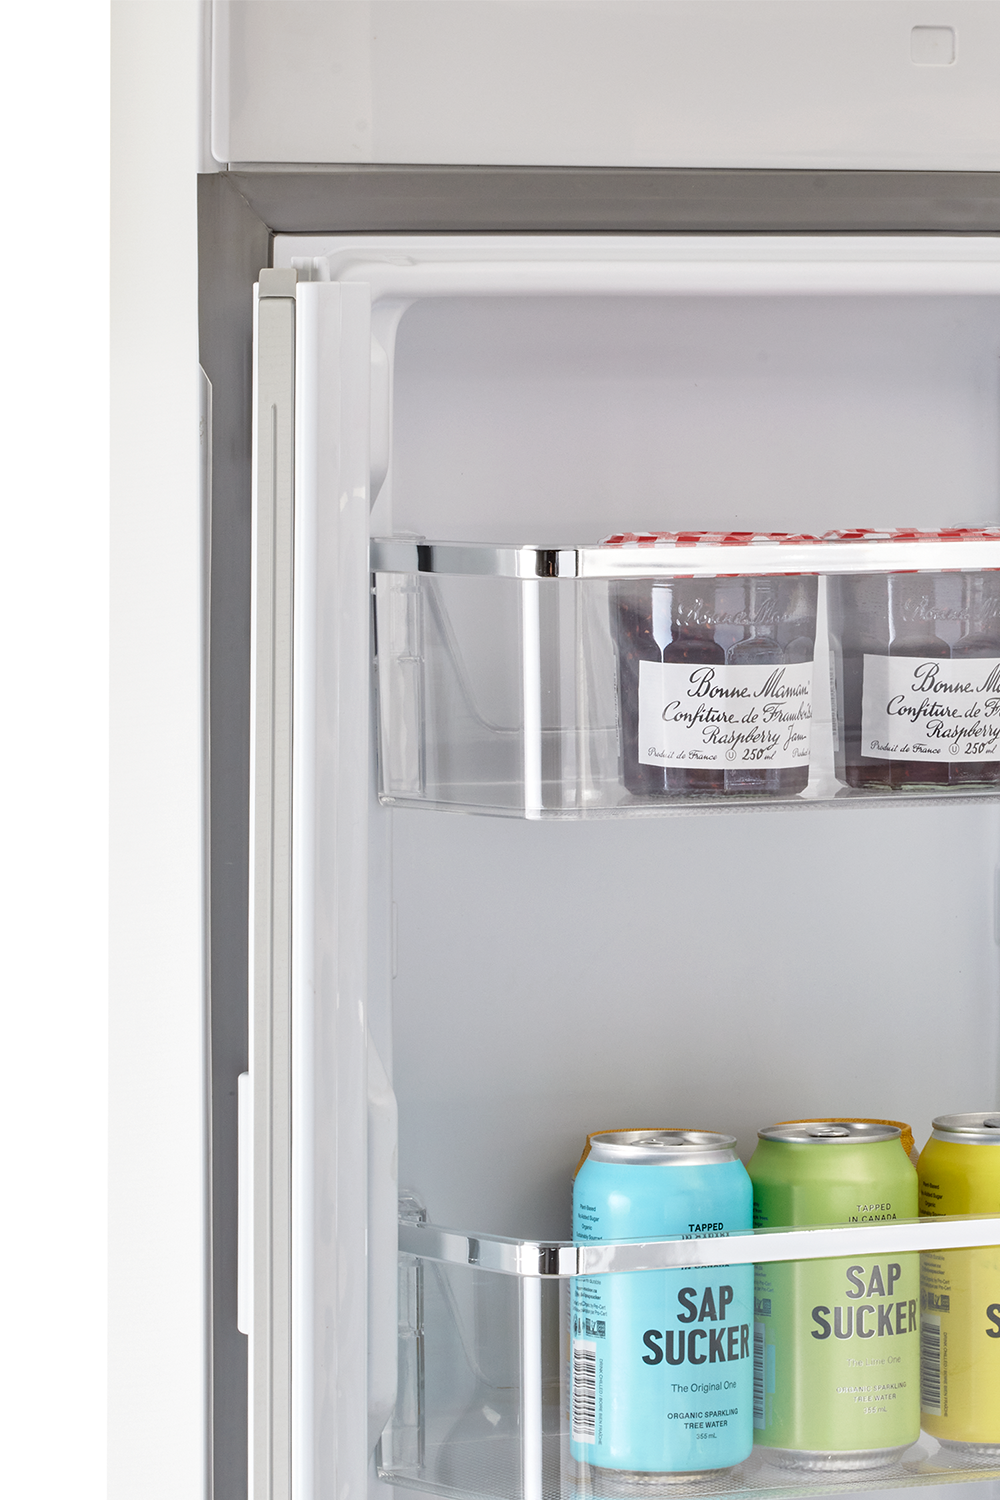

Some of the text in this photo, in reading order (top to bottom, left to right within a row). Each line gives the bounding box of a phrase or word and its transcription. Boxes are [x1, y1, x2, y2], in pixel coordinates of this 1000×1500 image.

[687, 667, 808, 698] Bonne Maman
[911, 662, 974, 693] Bonne
[662, 700, 760, 728] Confiture de
[886, 695, 980, 722] Confiture de
[702, 724, 807, 751] Raspberry Jam
[926, 719, 1000, 745] Raspberry
[648, 747, 764, 761] Produit France 250
[870, 740, 985, 755] Produit France 250
[856, 1203, 892, 1212] TAPPED
[688, 1222, 724, 1232] TAPPED
[846, 1262, 902, 1299] SAP
[676, 1285, 734, 1324] SAP
[810, 1299, 917, 1340] SUCKER
[642, 1324, 750, 1365] SUCKER
[847, 1356, 901, 1367] The Lime One
[671, 1380, 737, 1394] The Original One
[836, 1382, 907, 1394] ORGANIC SPARKLING
[854, 1393, 897, 1403] TREE WATER
[667, 1408, 738, 1420] ORGANIC SPARKLING
[705, 1420, 728, 1429] WATER
